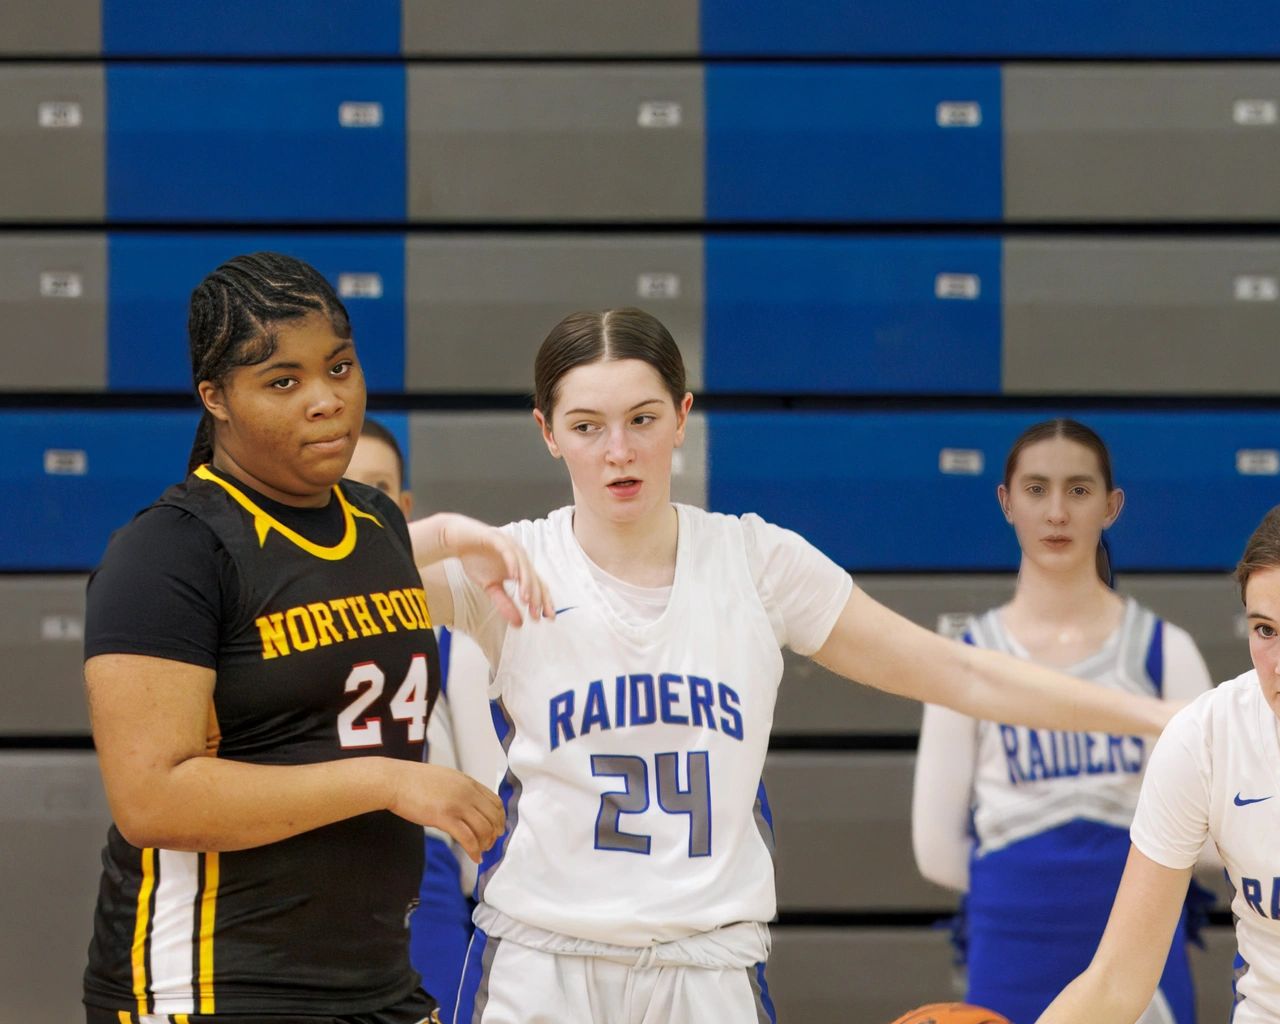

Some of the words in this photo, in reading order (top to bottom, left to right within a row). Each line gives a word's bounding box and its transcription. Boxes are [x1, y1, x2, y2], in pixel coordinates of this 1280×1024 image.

[255, 594, 383, 661] NORTH
[336, 652, 428, 750] 24
[548, 672, 744, 752] RAIDERS
[590, 750, 712, 858] 24
